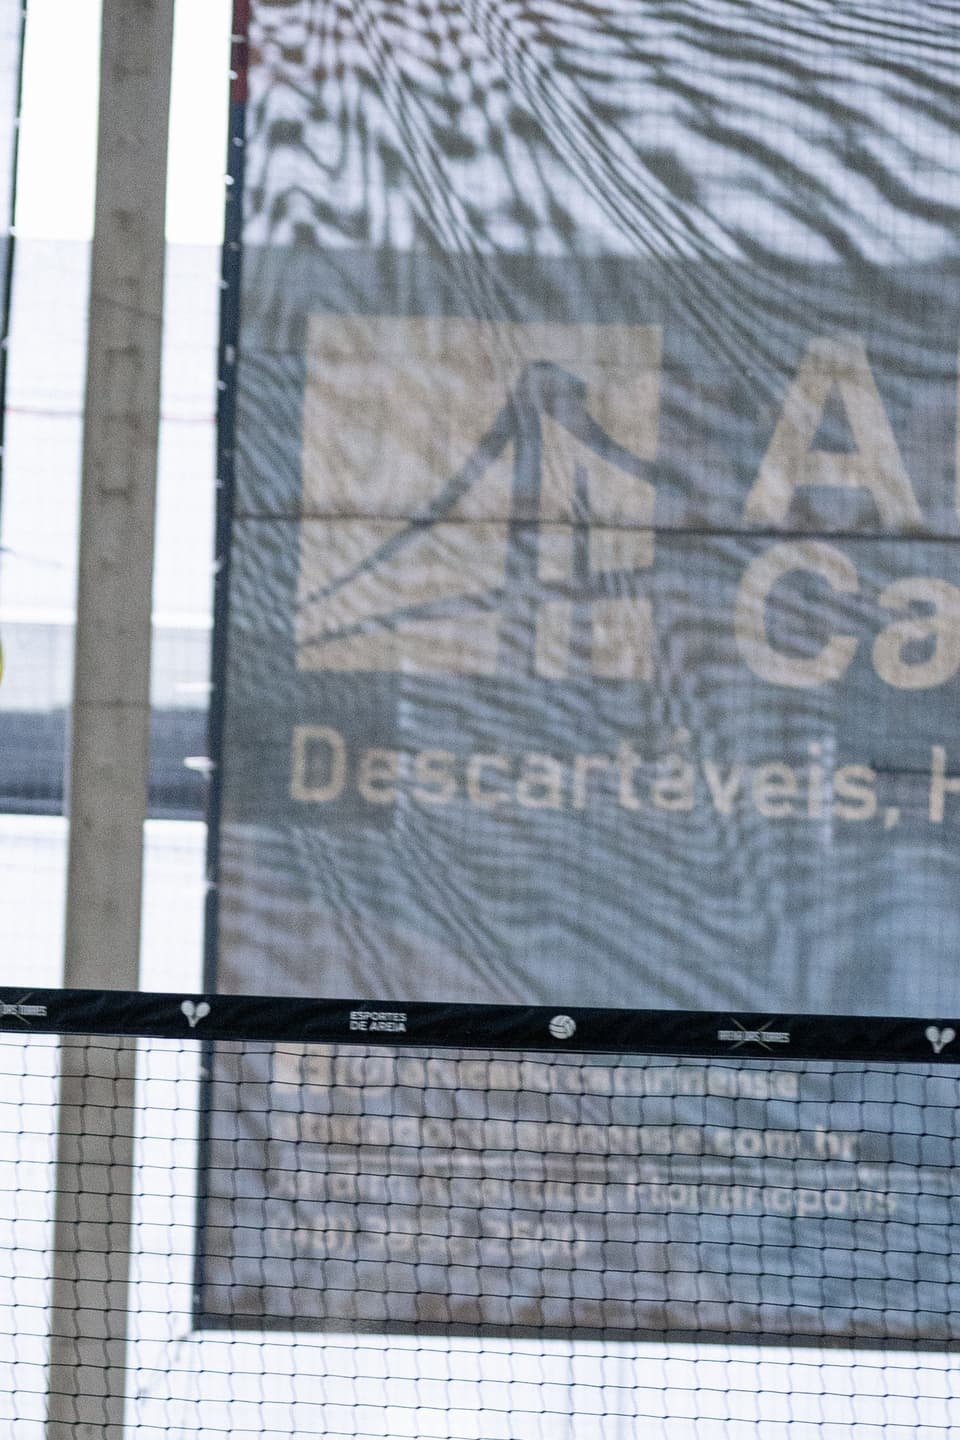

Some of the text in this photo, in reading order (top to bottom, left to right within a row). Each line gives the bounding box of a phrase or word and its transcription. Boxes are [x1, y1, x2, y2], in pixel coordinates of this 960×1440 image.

[349, 1011, 407, 1022] ESPORTES
[349, 1020, 407, 1033] DE AREIA
